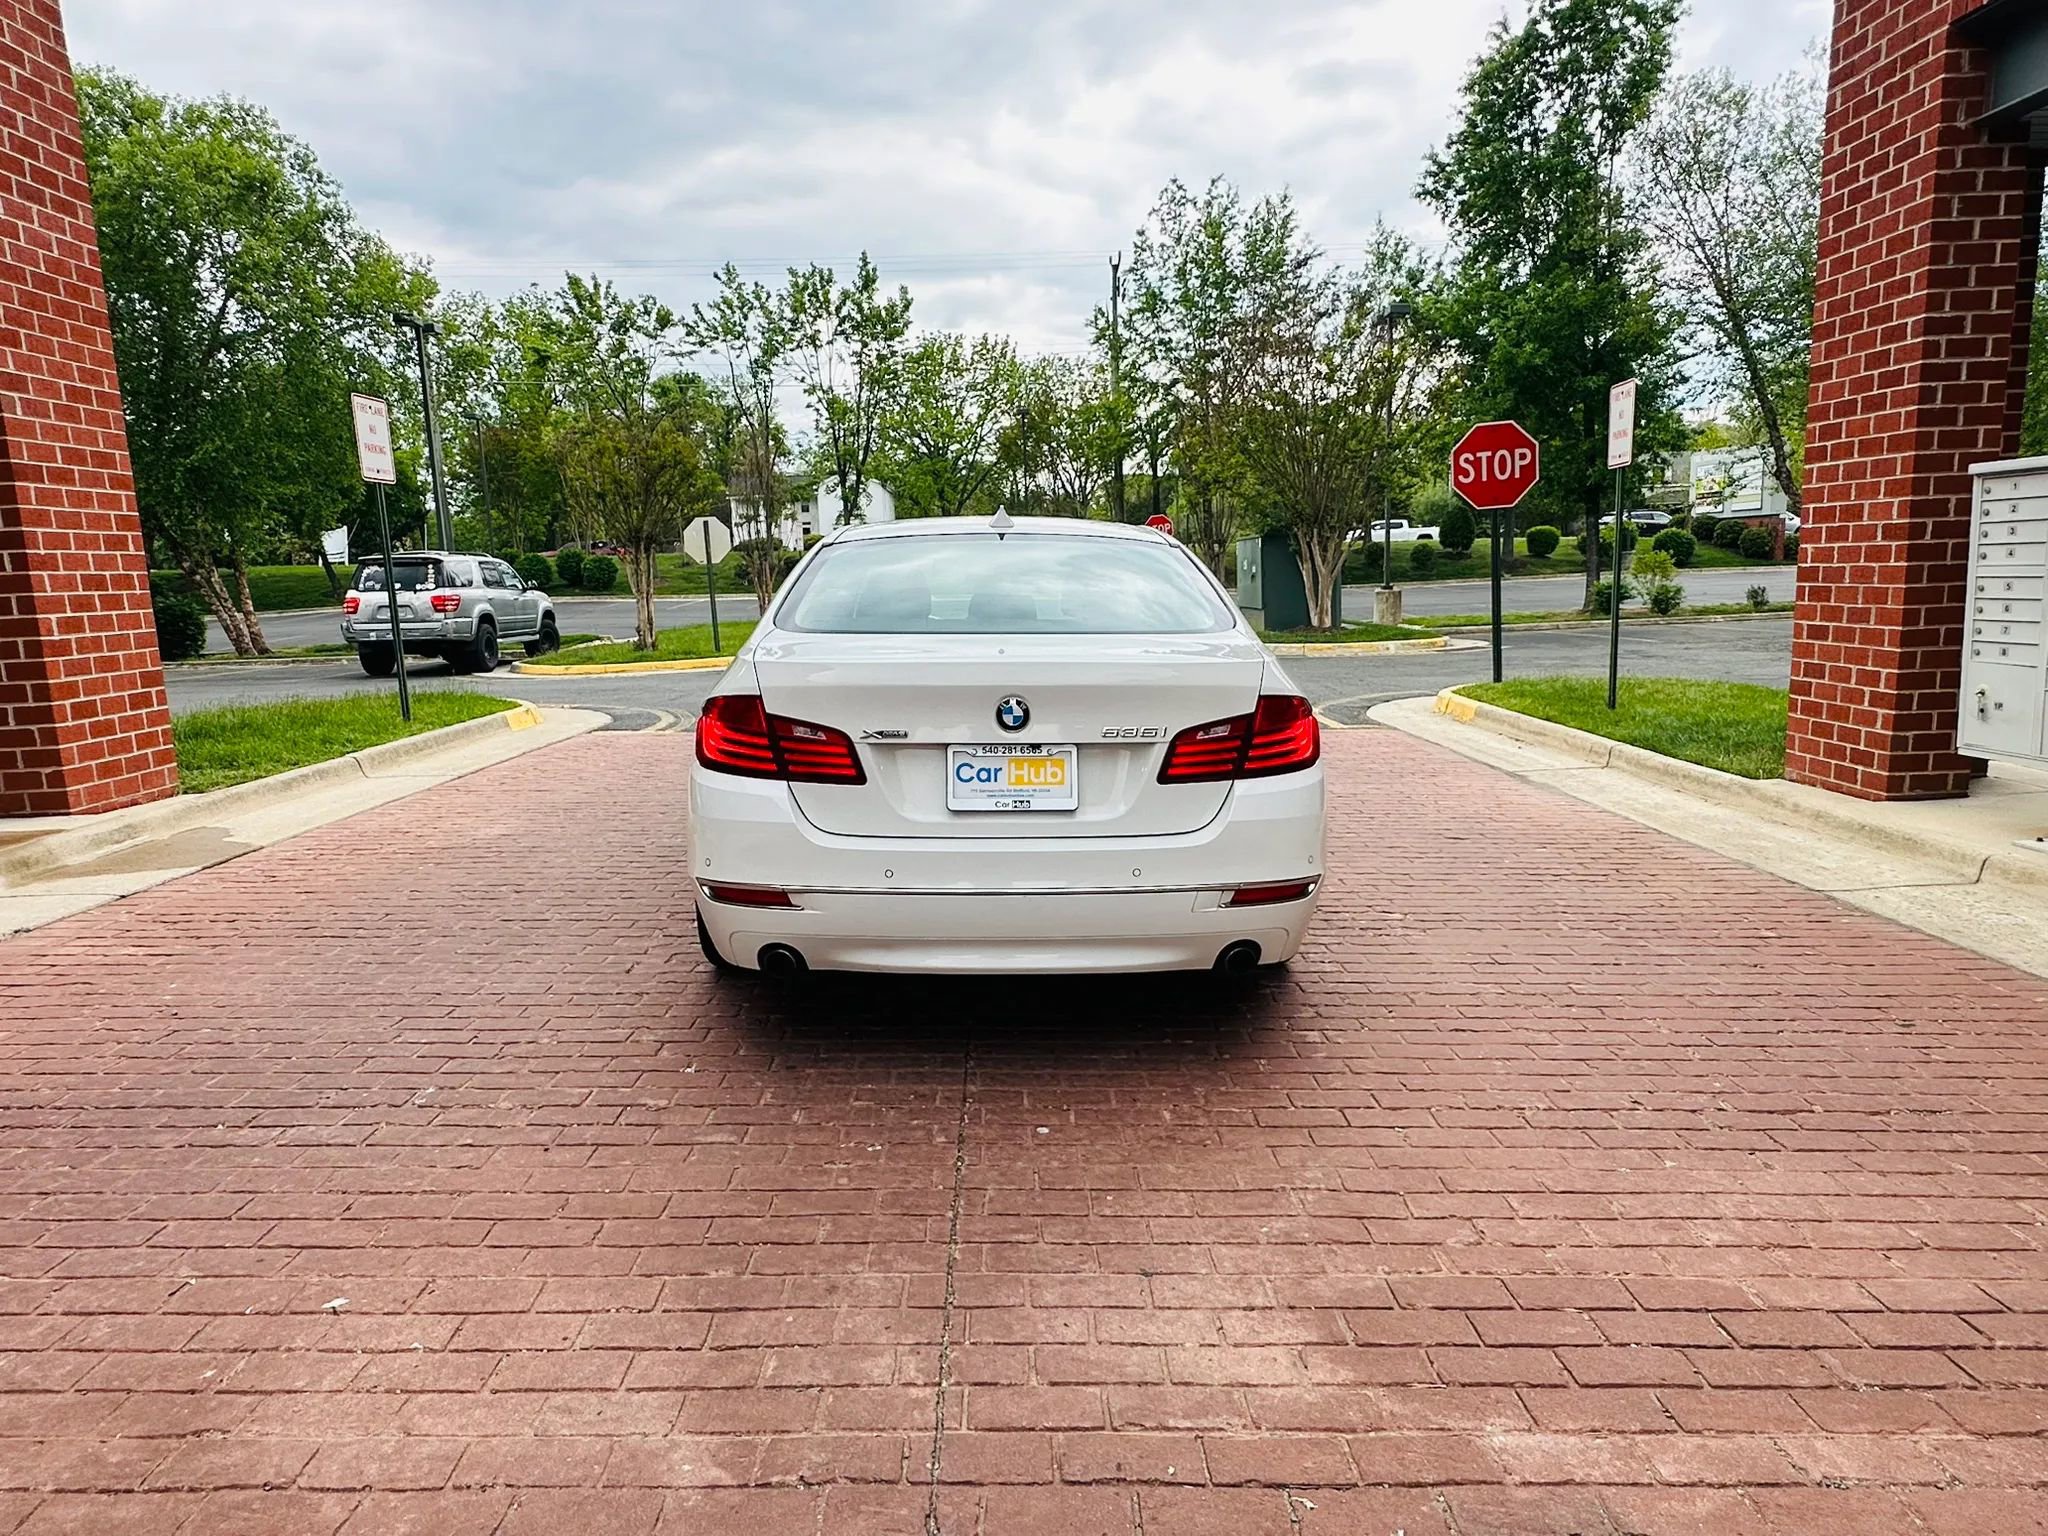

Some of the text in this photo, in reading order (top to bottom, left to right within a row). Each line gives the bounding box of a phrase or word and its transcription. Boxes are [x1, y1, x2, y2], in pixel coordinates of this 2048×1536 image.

[1458, 448, 1532, 484] STOP
[2011, 505, 2017, 513] 2
[956, 760, 1064, 784] Car Hub
[994, 800, 1031, 809] Car Hub
